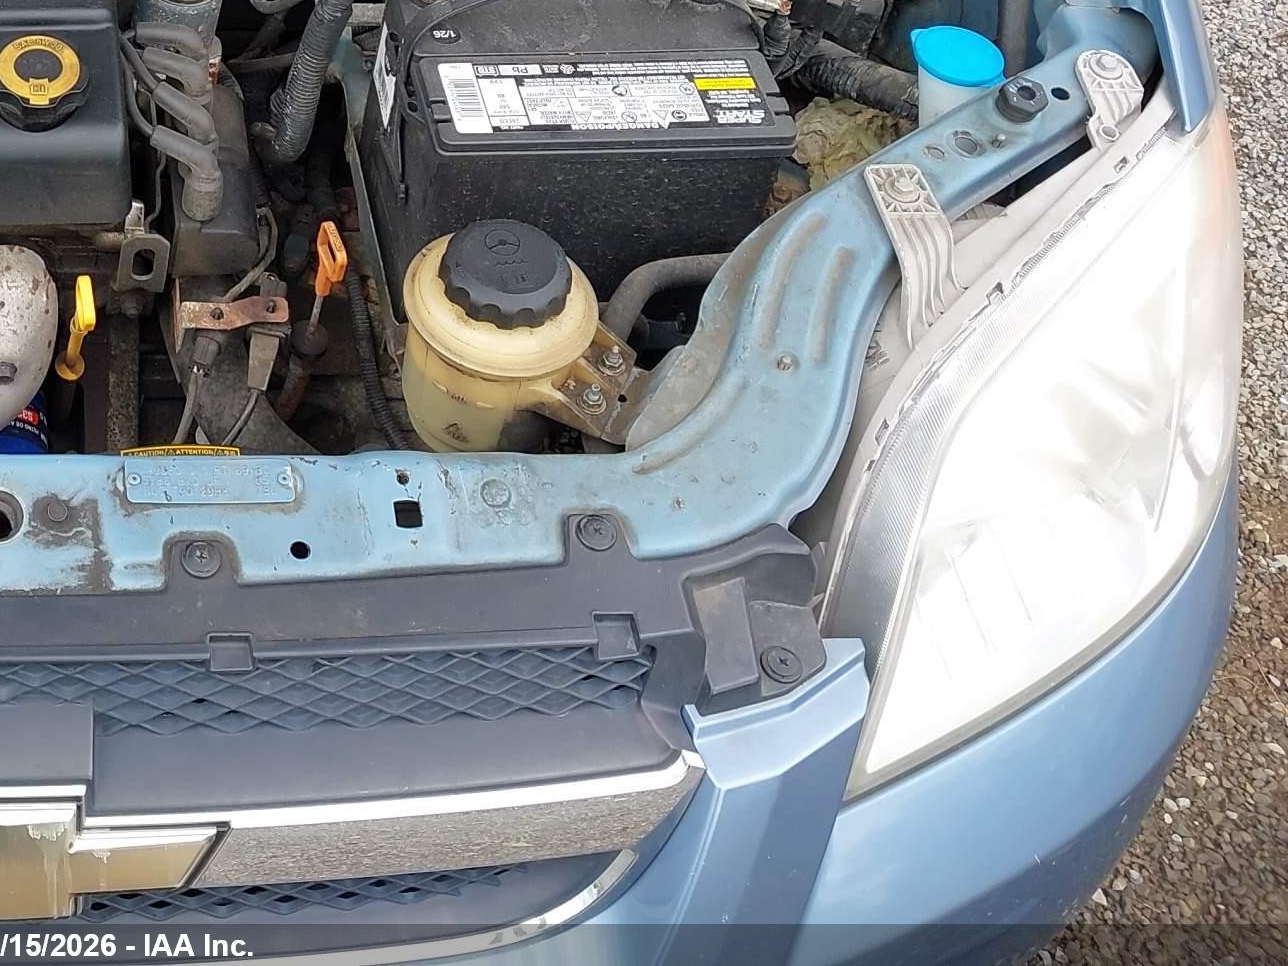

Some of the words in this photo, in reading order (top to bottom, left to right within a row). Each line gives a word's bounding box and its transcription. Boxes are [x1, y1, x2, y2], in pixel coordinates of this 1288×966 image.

[433, 30, 457, 38] 1/26
[14, 37, 33, 50] SAE
[512, 66, 528, 74] Pb
[716, 109, 765, 118] START
[717, 116, 762, 124] SUPER
